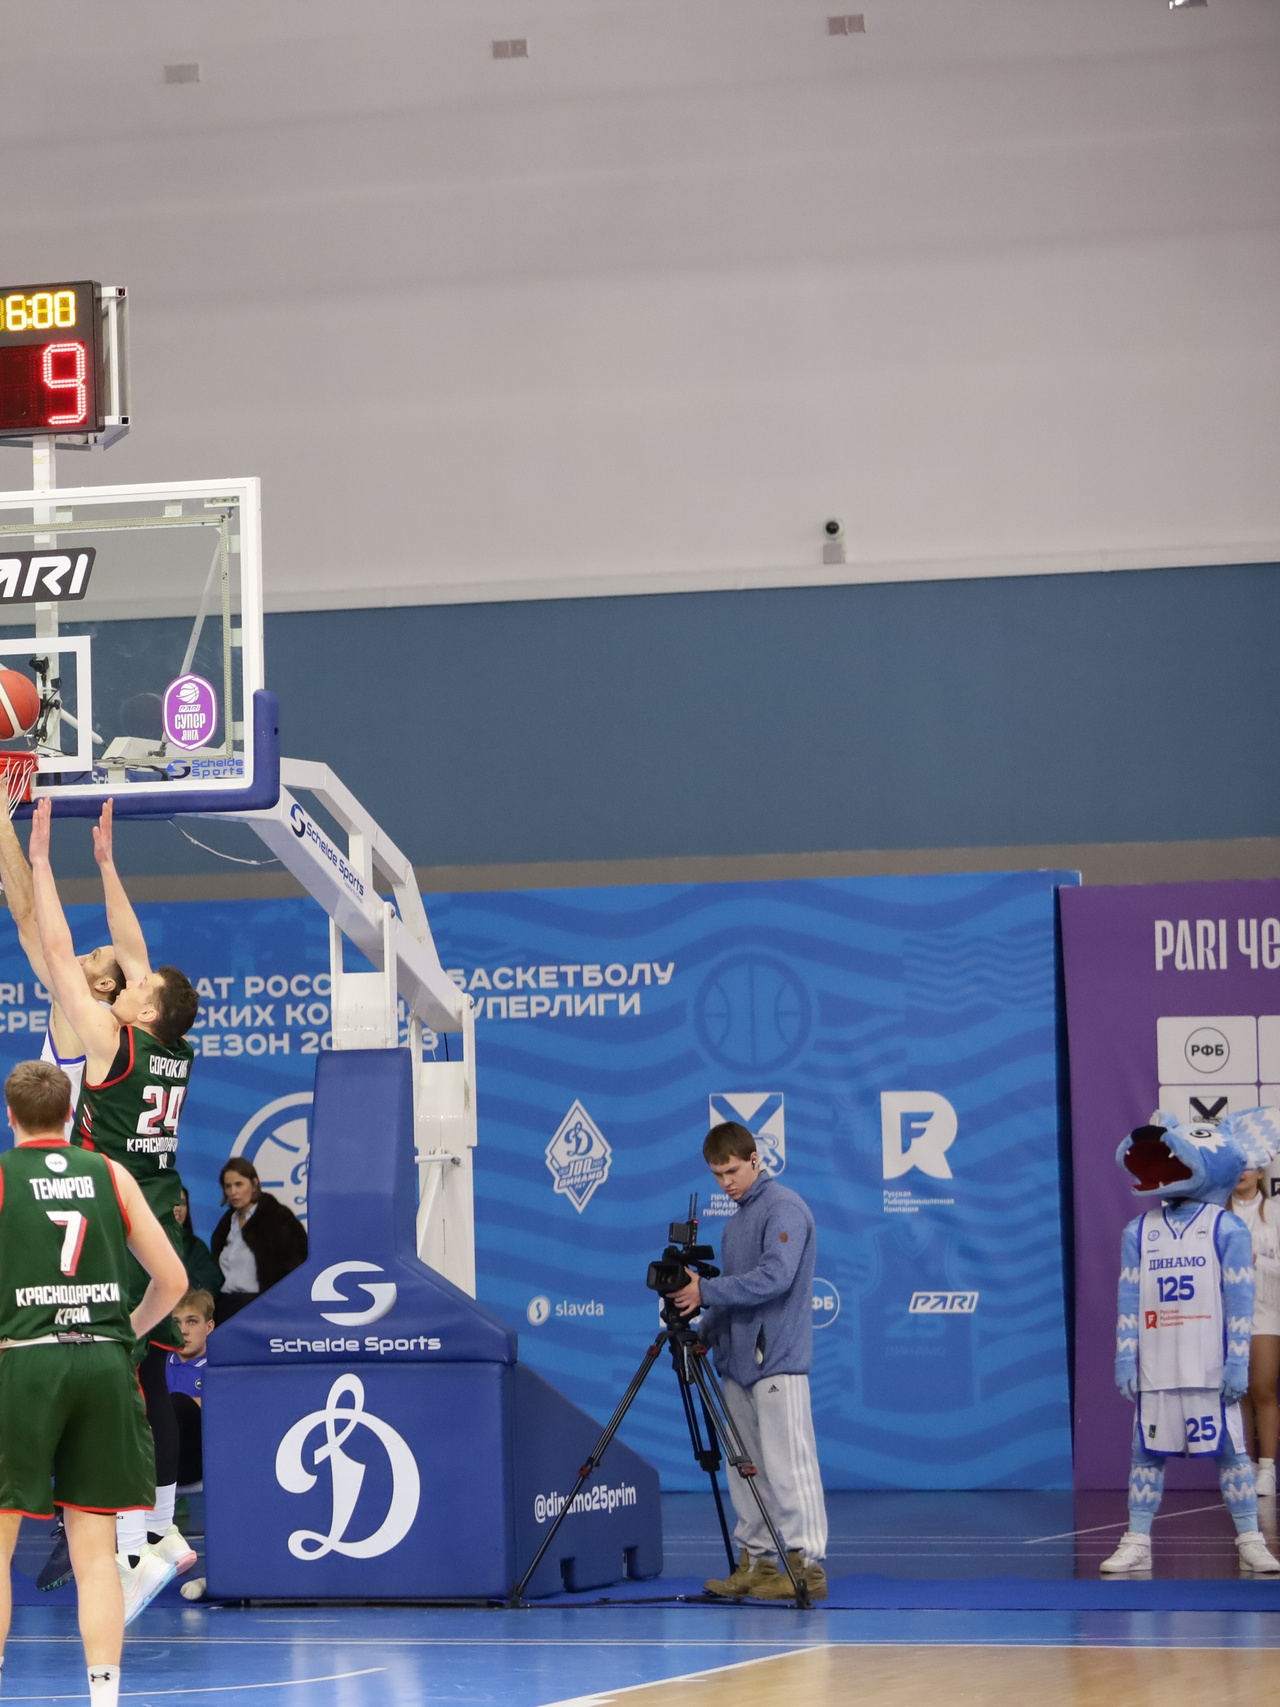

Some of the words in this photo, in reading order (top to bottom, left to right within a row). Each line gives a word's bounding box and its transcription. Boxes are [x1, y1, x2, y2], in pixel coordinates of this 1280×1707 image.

[43, 342, 86, 425] 9
[192, 758, 243, 769] Schelde
[192, 767, 243, 778] Sports
[306, 822, 338, 867] Schelde
[338, 858, 365, 896] Sports
[1155, 919, 1227, 971] PARI
[245, 974, 332, 998] РОСС
[446, 962, 675, 991] БАСКЕТБОЛУ
[473, 992, 641, 1019] УПЕРЛИГИ
[188, 1032, 290, 1057] СЕЗОН
[1191, 1045, 1224, 1056] РФБ
[136, 1085, 187, 1137] 24
[29, 1175, 95, 1200] ТЕМИРОВ
[45, 1210, 88, 1277] 7
[1148, 1256, 1207, 1271] ДИНАМО
[15, 1282, 121, 1307] КРАСНОДАРСКИ
[1156, 1275, 1195, 1302] 125
[555, 1300, 605, 1317] slavda
[812, 1296, 835, 1311] ФБ
[912, 1294, 976, 1311] PARI
[54, 1305, 91, 1326] КРАЙ
[270, 1337, 360, 1353] Schelde
[364, 1335, 442, 1355] Sports
[1186, 1415, 1217, 1443] 25
